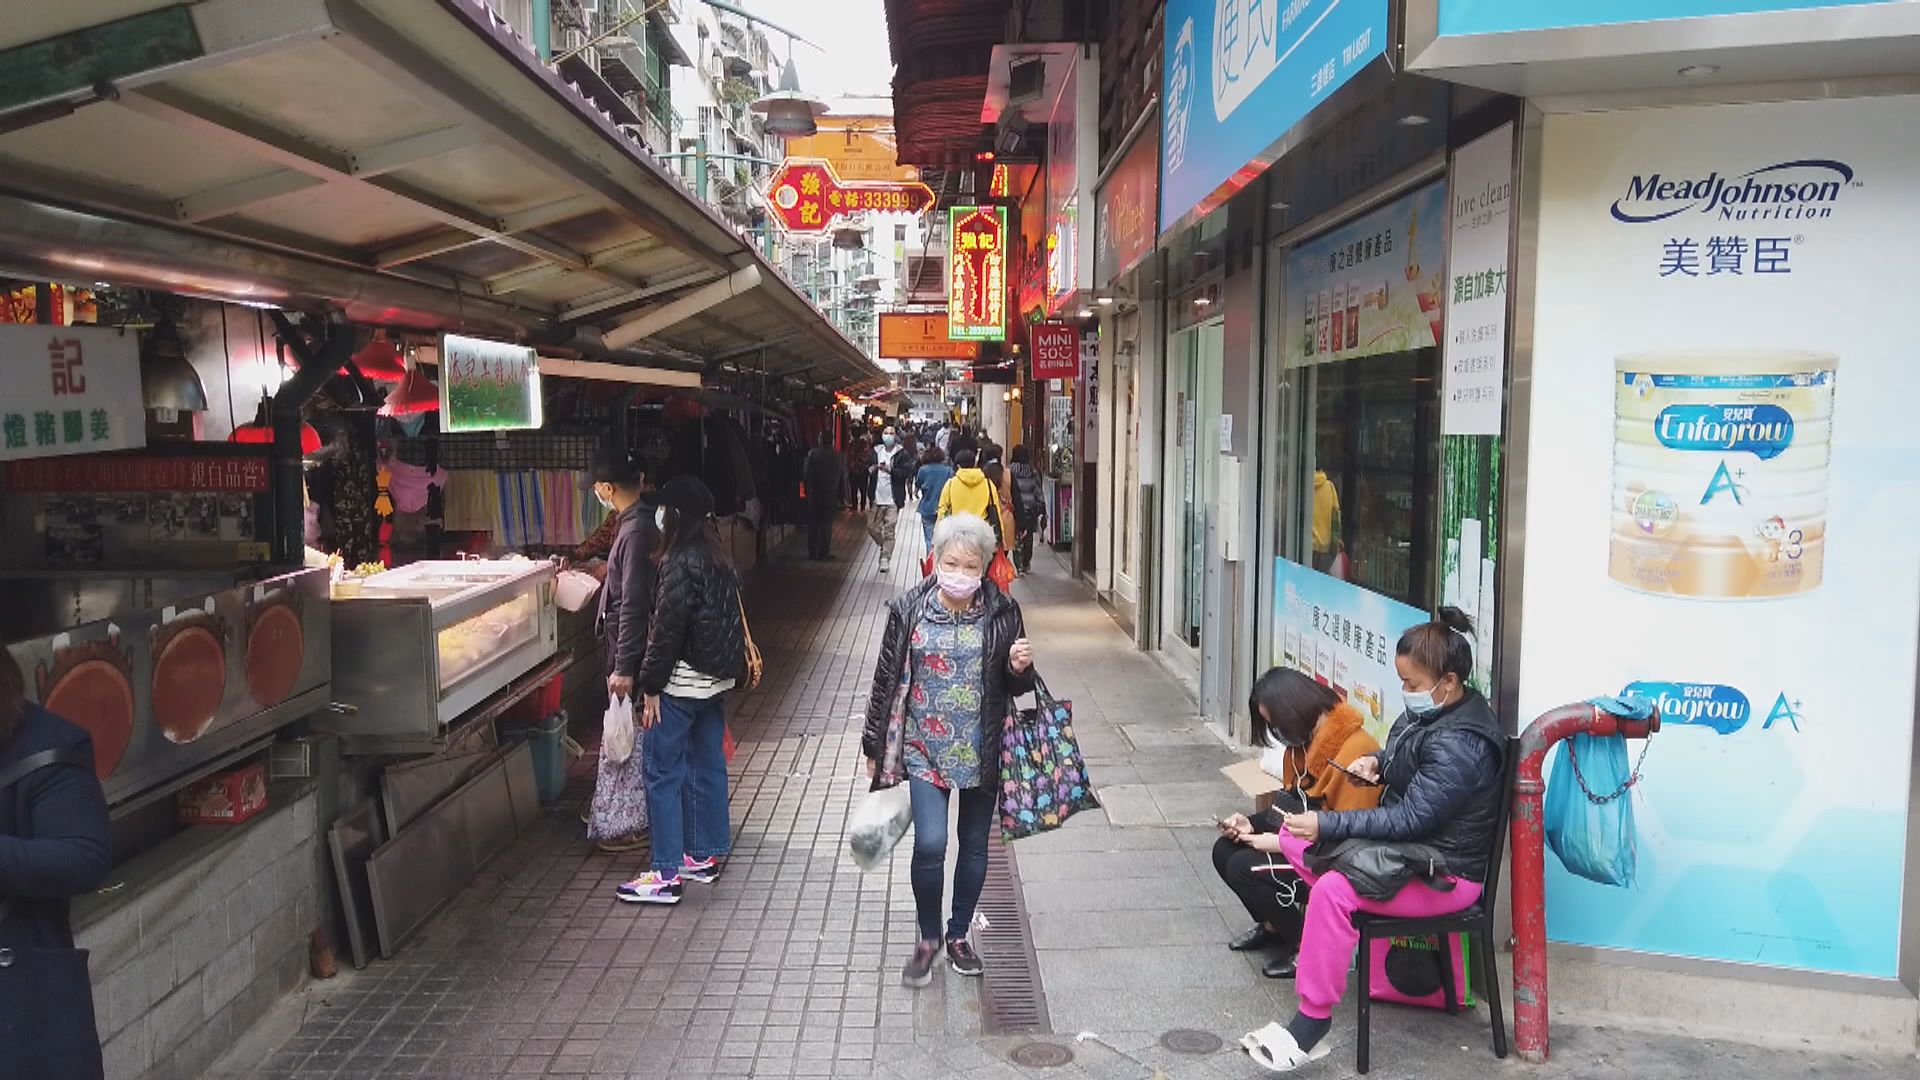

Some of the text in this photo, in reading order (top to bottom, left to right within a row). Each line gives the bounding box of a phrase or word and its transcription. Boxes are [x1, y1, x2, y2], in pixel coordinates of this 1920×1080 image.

[1456, 182, 1510, 217] live clean
[1719, 204, 1832, 221] Nutrition
[1454, 264, 1507, 305] 源自加拿大
[1039, 334, 1072, 347] MINI
[48, 336, 86, 396] 記
[1661, 413, 1789, 449] Enfagrow
[1788, 530, 1803, 559] 3
